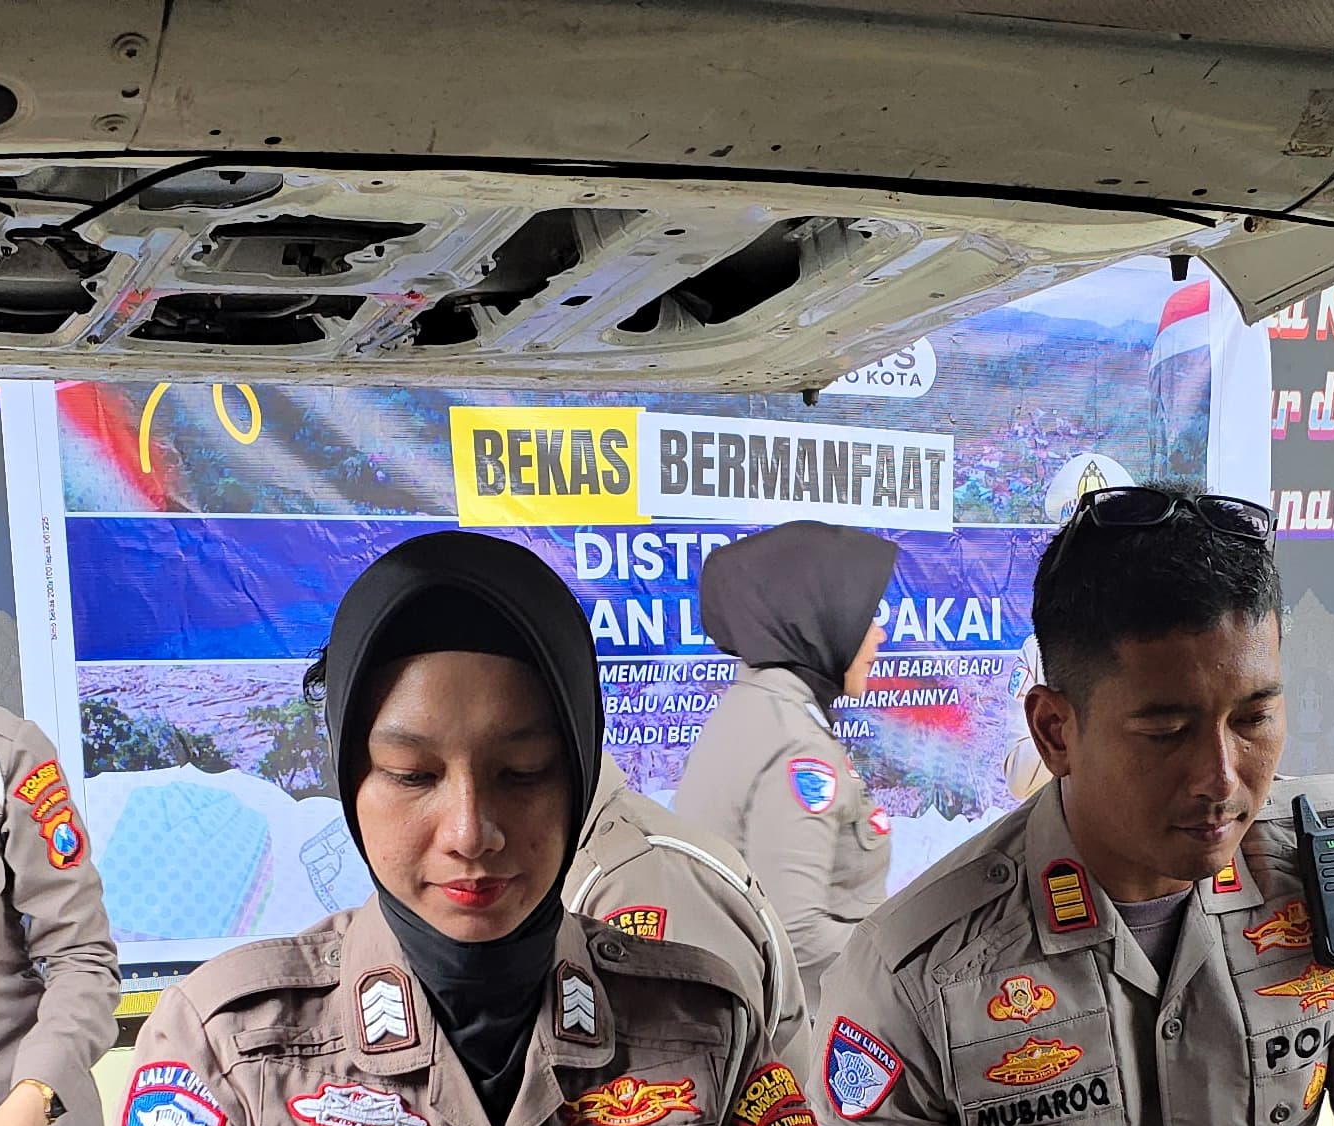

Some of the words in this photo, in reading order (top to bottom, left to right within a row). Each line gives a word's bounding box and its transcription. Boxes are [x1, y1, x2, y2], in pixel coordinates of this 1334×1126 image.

[867, 371, 922, 387] KOTA
[472, 428, 631, 497] BEKAS
[659, 429, 946, 512] BERMANFAAT
[599, 664, 687, 683] MEMILIKI
[692, 663, 738, 682] CERI
[866, 660, 895, 678] AN
[897, 659, 956, 678] BABAK
[958, 658, 1003, 676] BARU
[605, 695, 658, 714] BAJU
[662, 694, 719, 713] ANDA
[829, 688, 959, 708] MBIARKANNYA
[603, 726, 663, 745] NJADI
[838, 1022, 862, 1042] LALU
[862, 1036, 896, 1070] LINTAS
[137, 1066, 177, 1088] LALU
